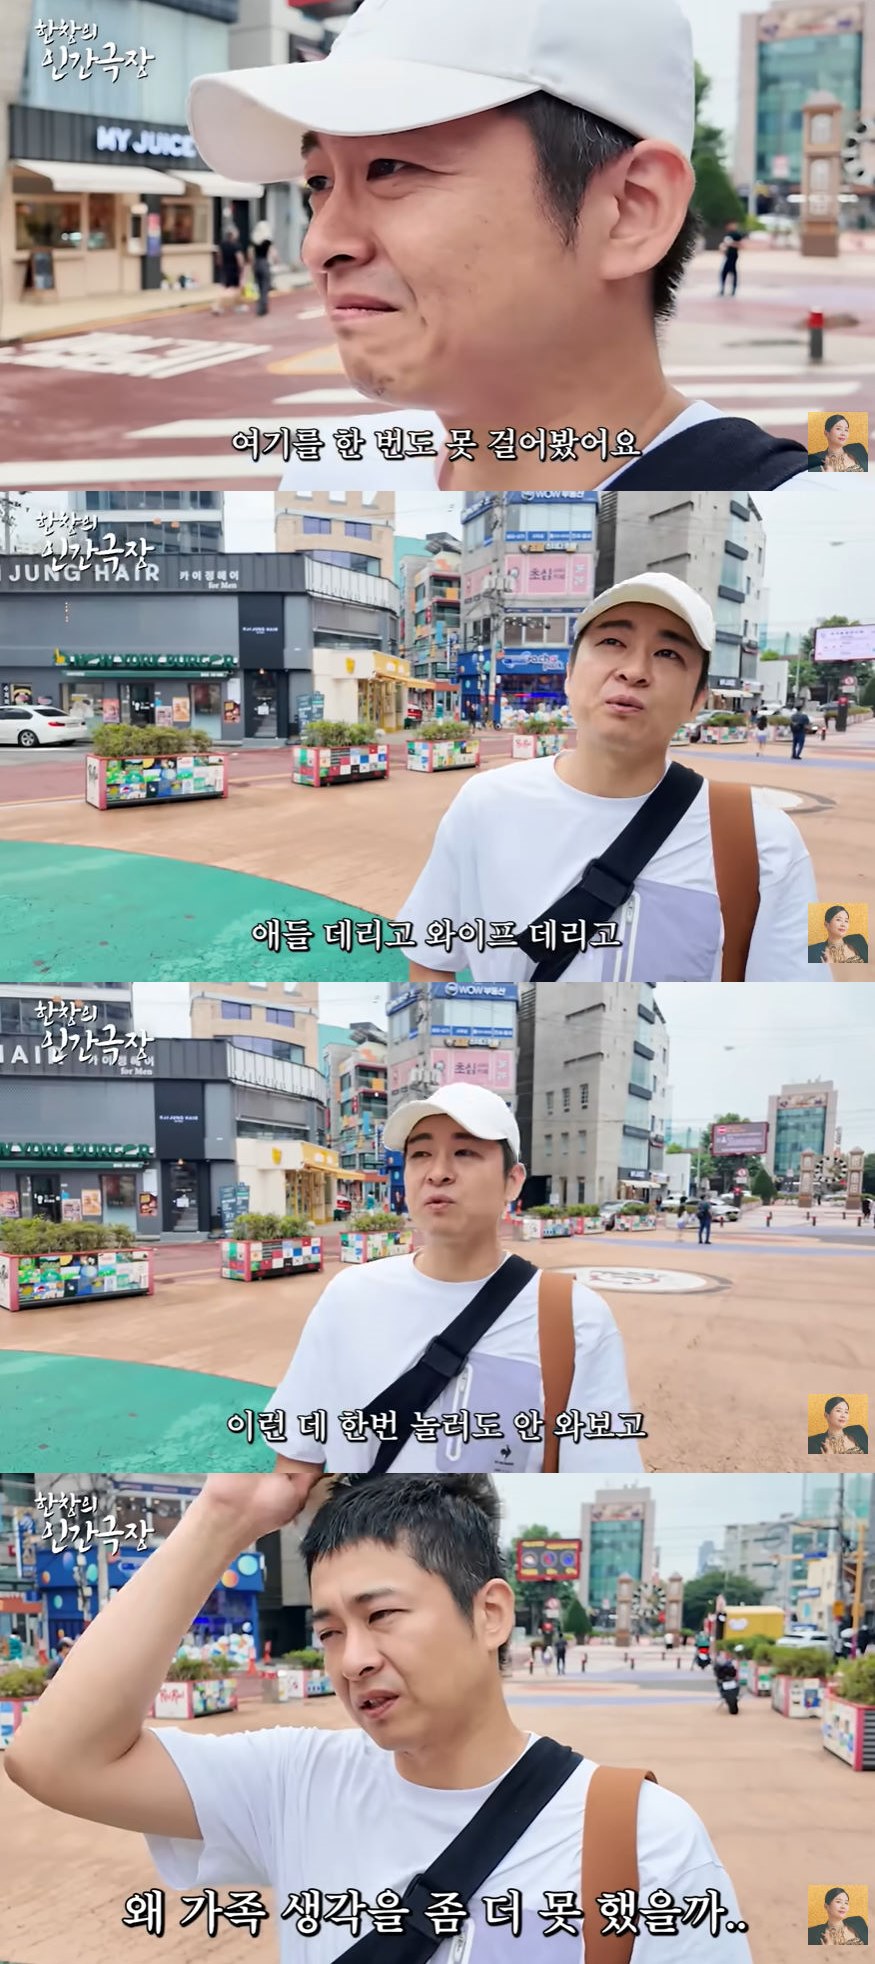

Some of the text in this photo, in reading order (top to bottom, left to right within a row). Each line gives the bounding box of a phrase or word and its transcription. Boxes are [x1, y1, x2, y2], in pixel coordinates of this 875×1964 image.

[97, 125, 197, 158] MY JUICE
[8, 563, 160, 582] JUNG HAIR
